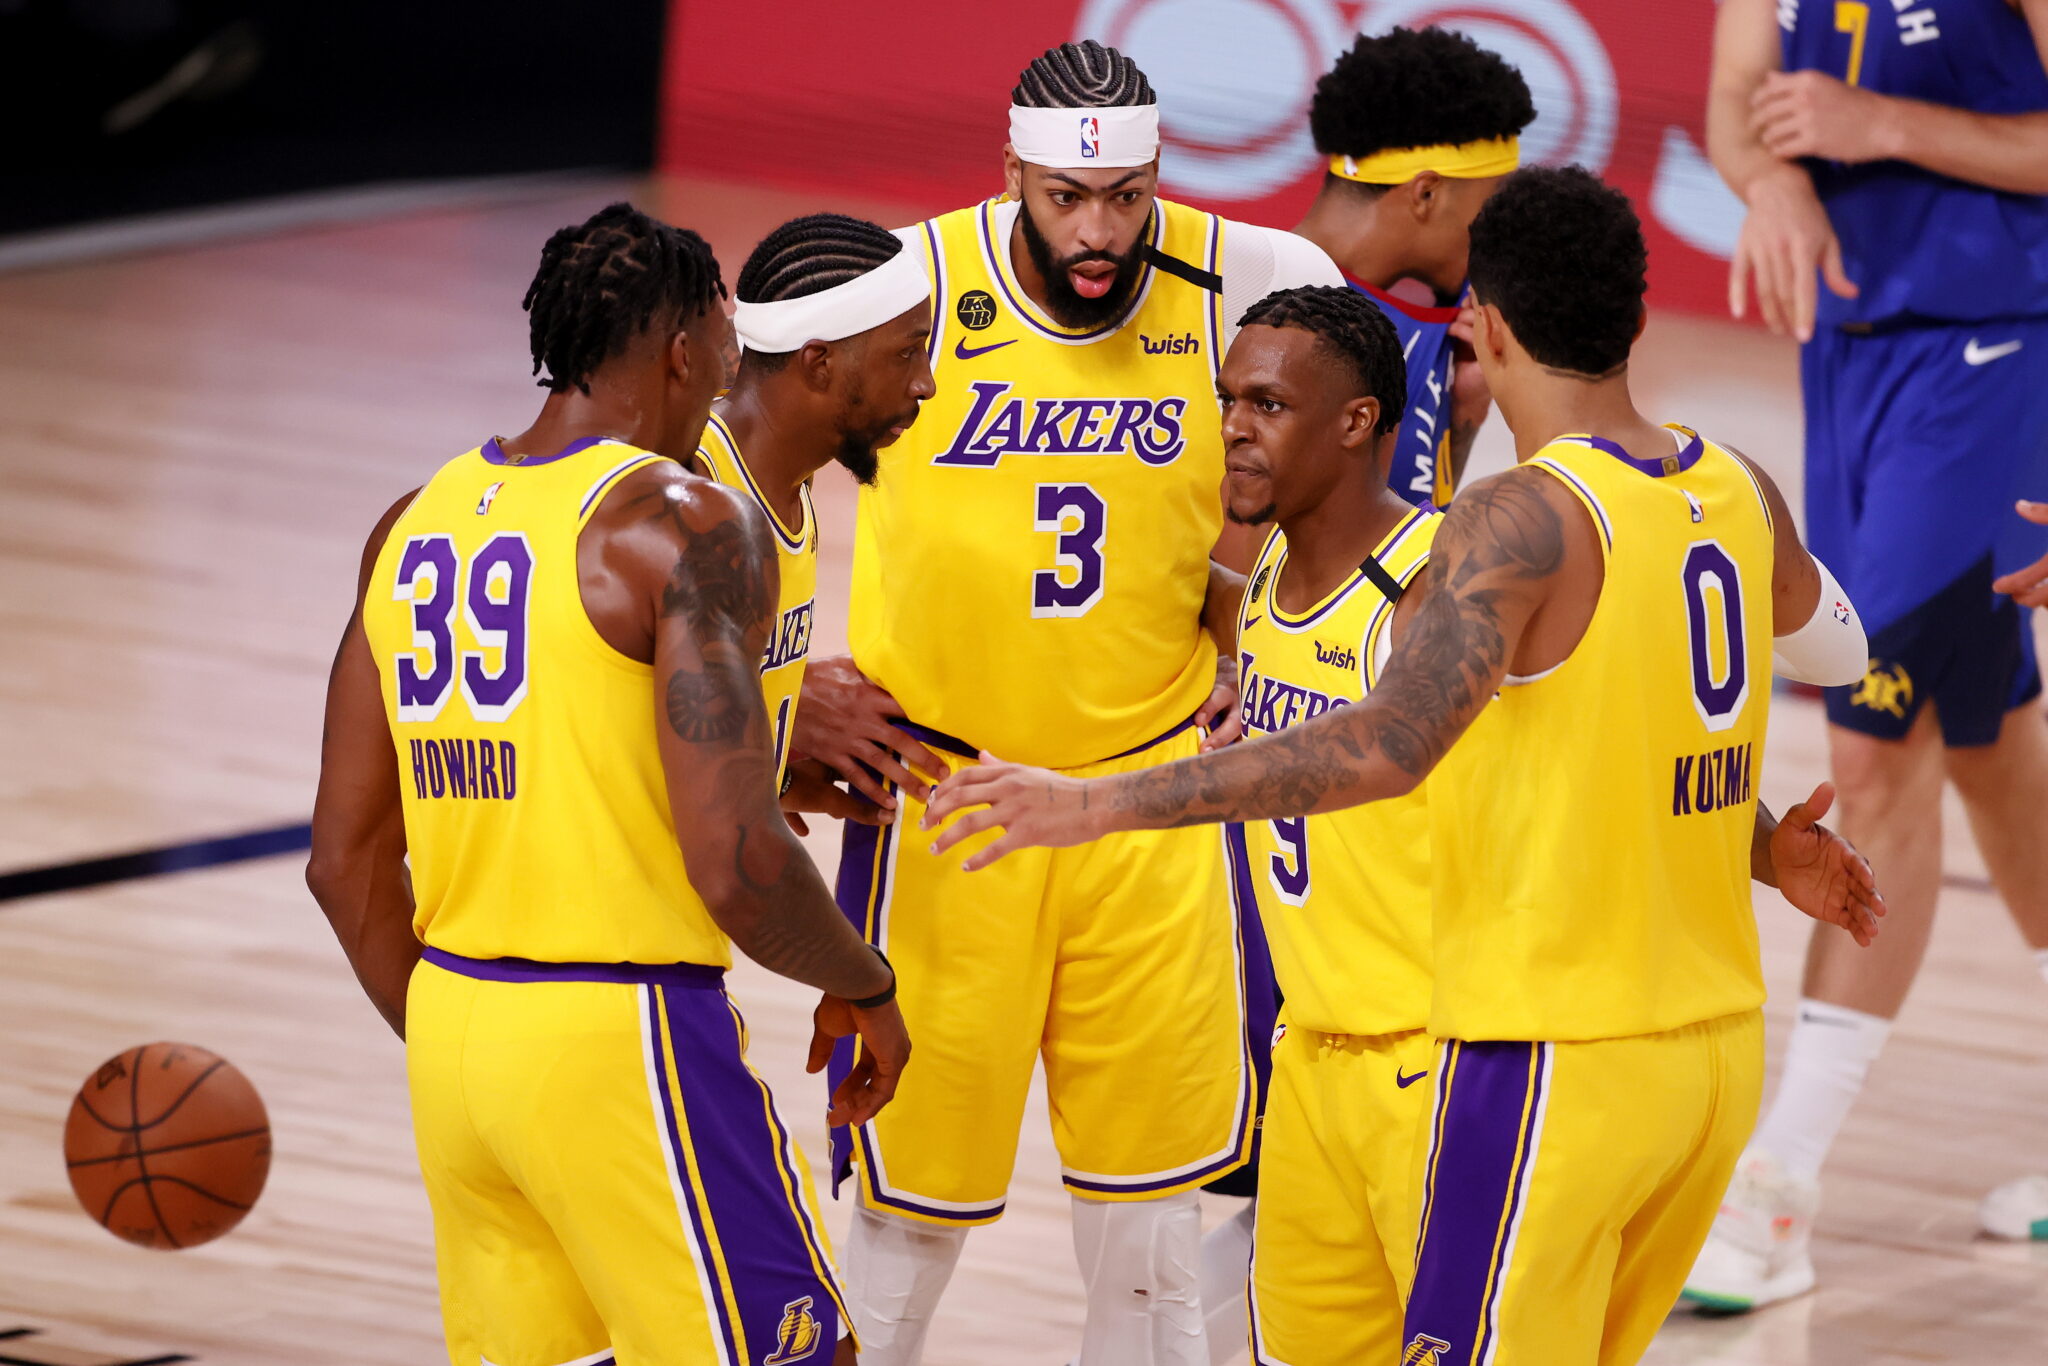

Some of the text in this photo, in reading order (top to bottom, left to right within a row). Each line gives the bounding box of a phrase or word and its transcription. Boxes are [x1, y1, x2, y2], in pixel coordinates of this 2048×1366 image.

[1139, 332, 1200, 354] wish
[932, 381, 1188, 468] LAKERS
[1031, 482, 1108, 619] 3
[392, 531, 536, 722] 39
[1314, 639, 1356, 672] wish
[1680, 538, 1750, 733] 0
[409, 739, 516, 800] HOWARD
[1672, 742, 1752, 816] KUZMA
[1268, 815, 1312, 909] 9
